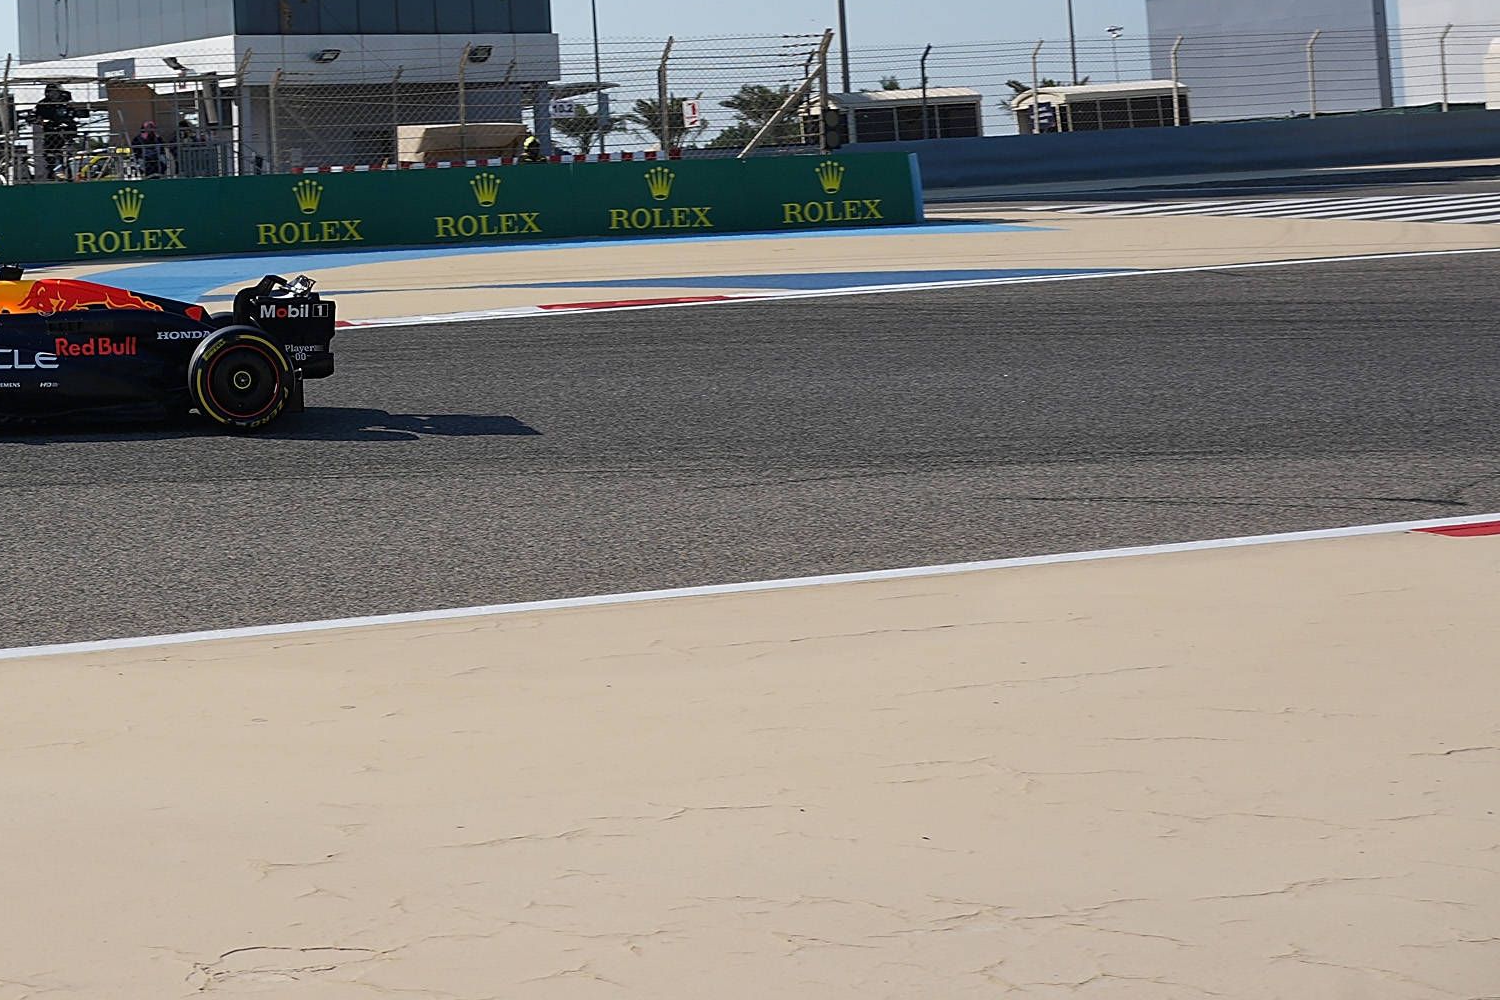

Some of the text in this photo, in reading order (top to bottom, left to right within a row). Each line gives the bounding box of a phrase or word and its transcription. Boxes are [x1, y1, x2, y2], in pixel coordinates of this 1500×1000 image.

[609, 207, 713, 229] ROLEX
[783, 200, 883, 223] ROLEX
[257, 220, 363, 243] ROLEX
[435, 213, 541, 237] ROLEX
[75, 229, 186, 253] ROLEX
[260, 304, 309, 318] Mobil
[156, 330, 211, 340] HONDA
[55, 336, 137, 357] Red Bull
